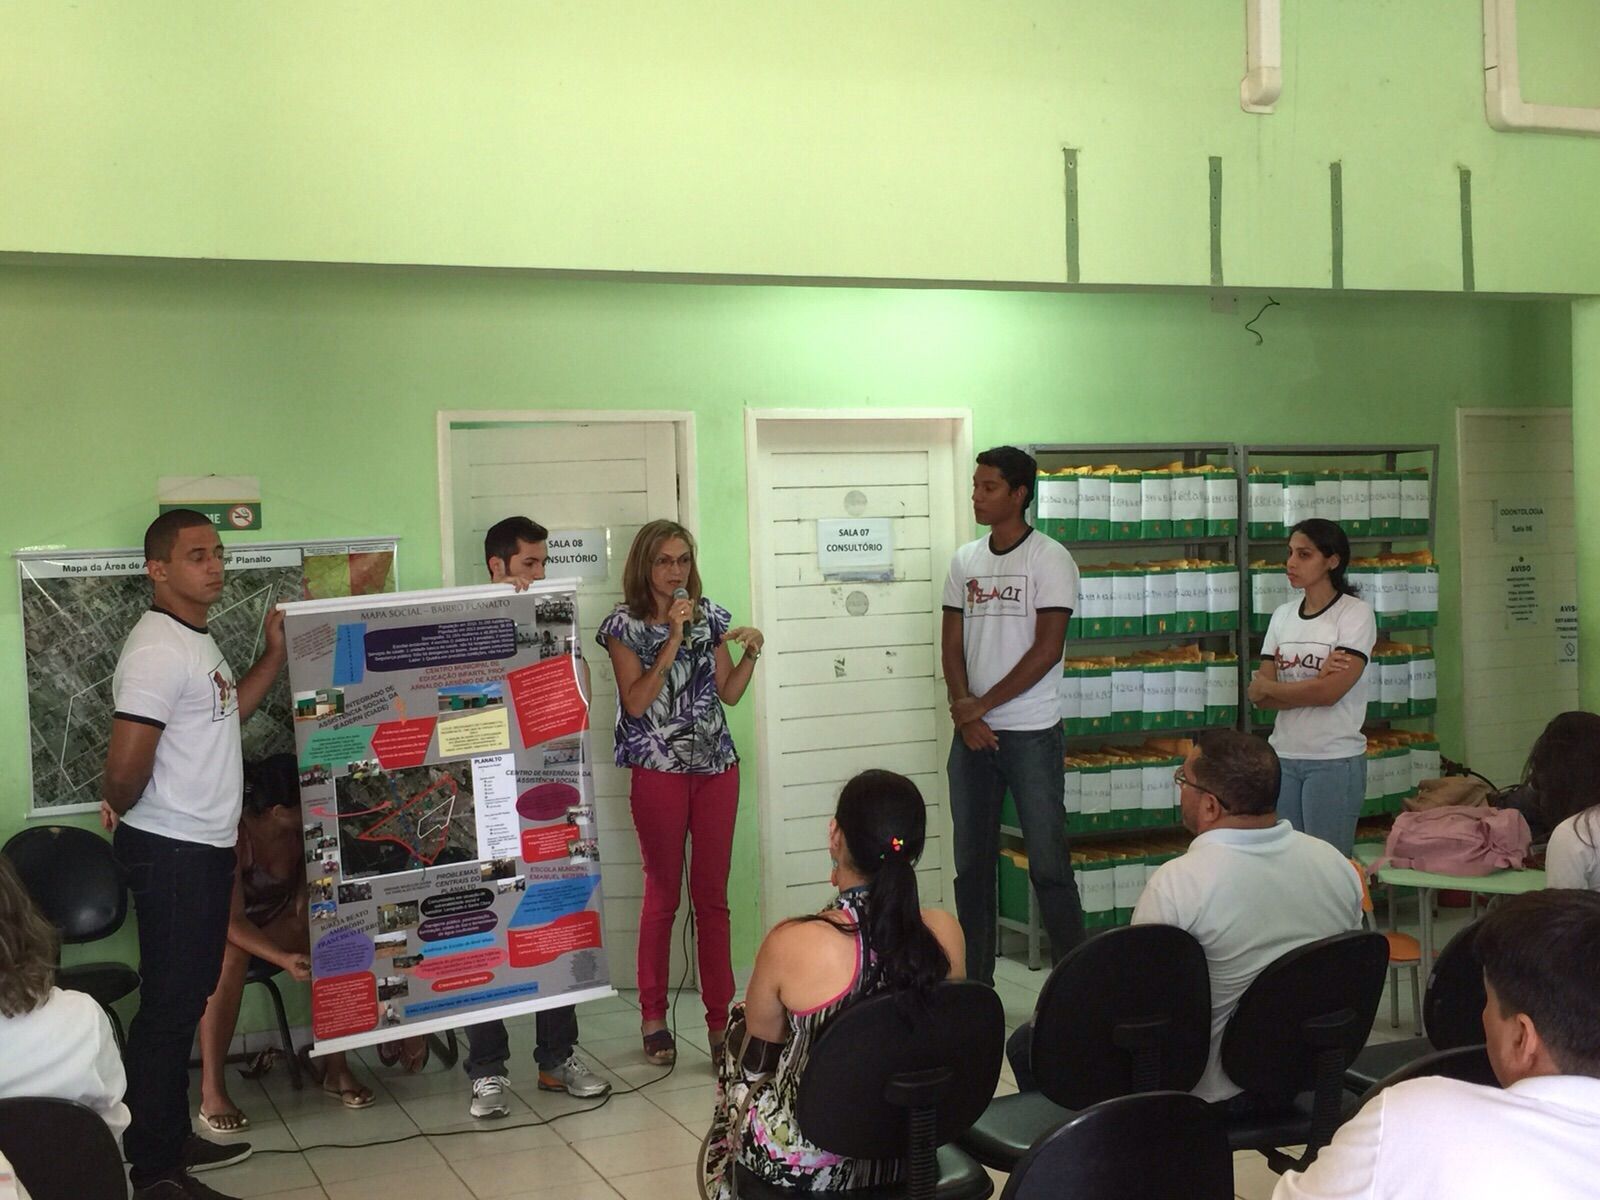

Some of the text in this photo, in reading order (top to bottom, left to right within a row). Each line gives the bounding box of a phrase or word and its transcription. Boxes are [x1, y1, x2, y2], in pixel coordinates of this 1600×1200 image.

[1500, 508, 1544, 516] ODONTOLOGIA
[860, 528, 870, 536] 07
[548, 539, 583, 548] SALA 08
[826, 542, 882, 552] CONSULTÓRIO
[236, 556, 272, 564] Planalto
[547, 554, 598, 564] NSULTÓRIO
[62, 564, 88, 573] Mapa
[90, 564, 102, 572] da
[104, 562, 126, 570] Área
[128, 562, 140, 570] de
[360, 610, 387, 620] MAPA
[389, 608, 422, 617] SOCIAL
[431, 604, 464, 615] BAIRRO
[426, 666, 452, 674] CENTRO
[454, 662, 488, 672] MUNICIPAL
[419, 672, 456, 682] EDUCAÇÃO
[458, 670, 486, 678] INFANTIL
[410, 681, 444, 690] ARNALDO
[346, 690, 384, 709] INTEGRADO
[385, 685, 395, 694] DE
[318, 691, 399, 729] ASSISTÊNCIA SOCIAL DA
[436, 868, 478, 880] PROBLEMAS
[436, 877, 468, 888] CENTRAIS
[440, 884, 476, 894] PLANALTO
